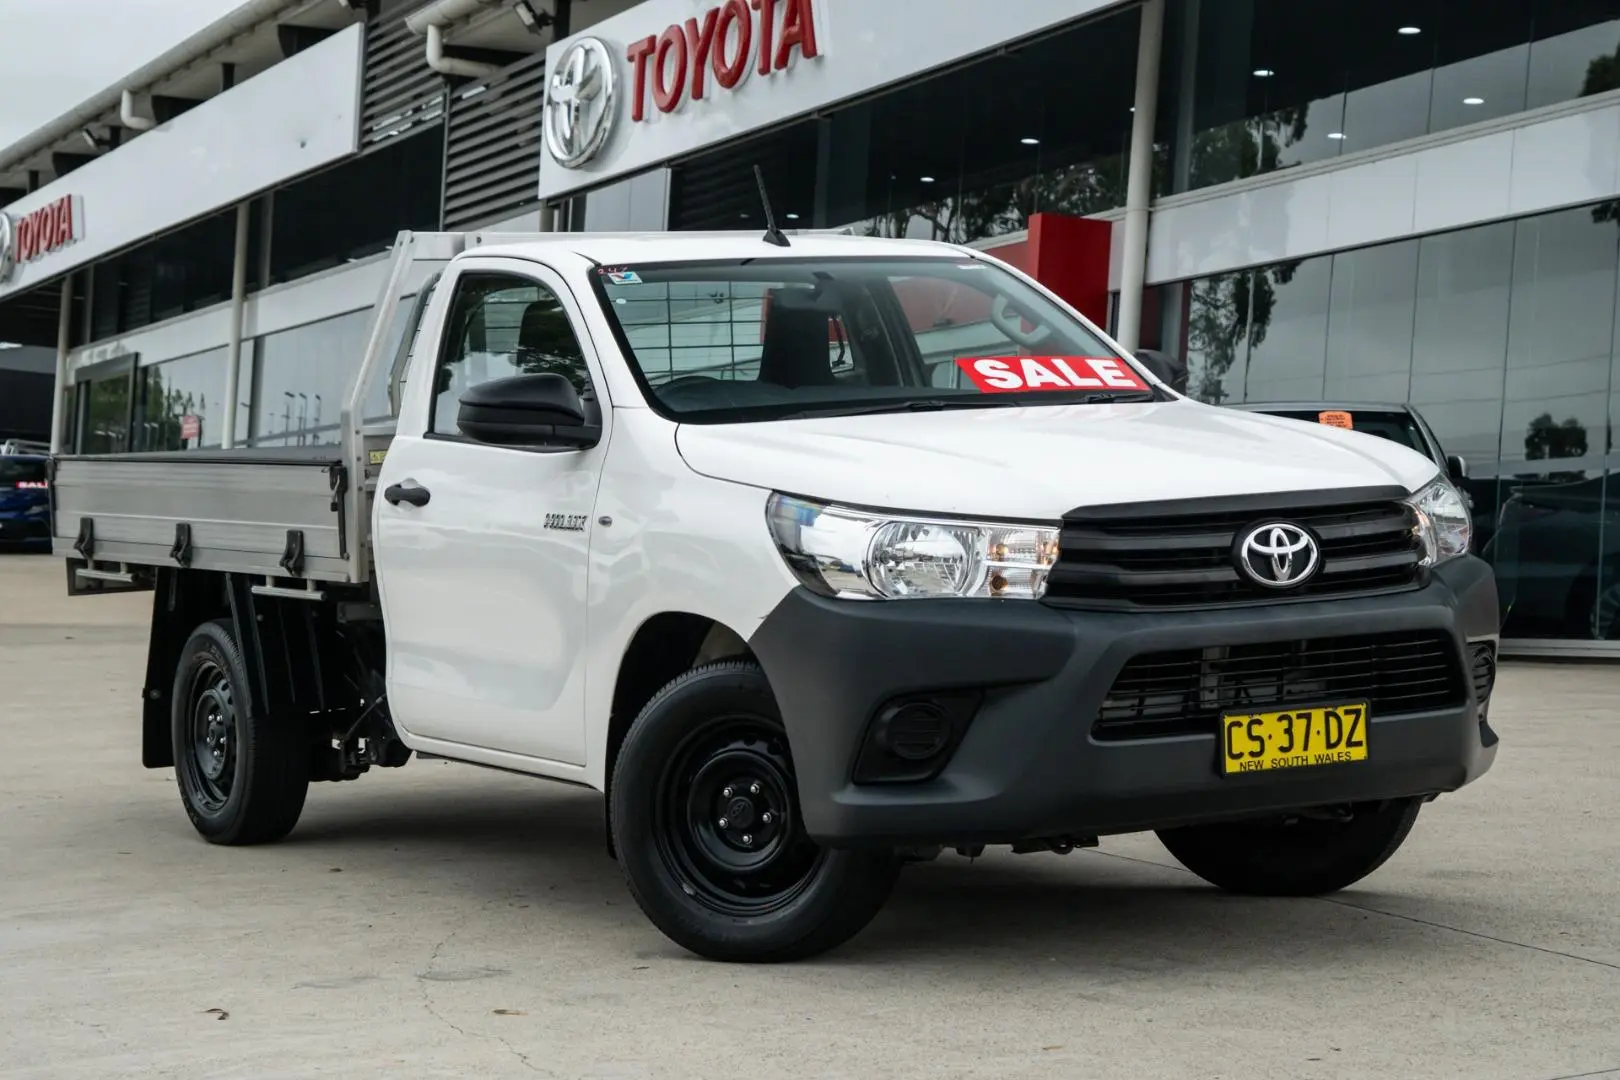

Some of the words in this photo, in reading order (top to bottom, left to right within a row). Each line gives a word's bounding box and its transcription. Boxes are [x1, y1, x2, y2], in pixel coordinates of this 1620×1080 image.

[627, 0, 818, 122] TOYOTA
[15, 194, 73, 264] TOYOTA
[973, 359, 1137, 389] SALE
[1240, 760, 1264, 772] NEW
[1271, 755, 1309, 769] SOUTH
[1314, 752, 1352, 765] WALES
